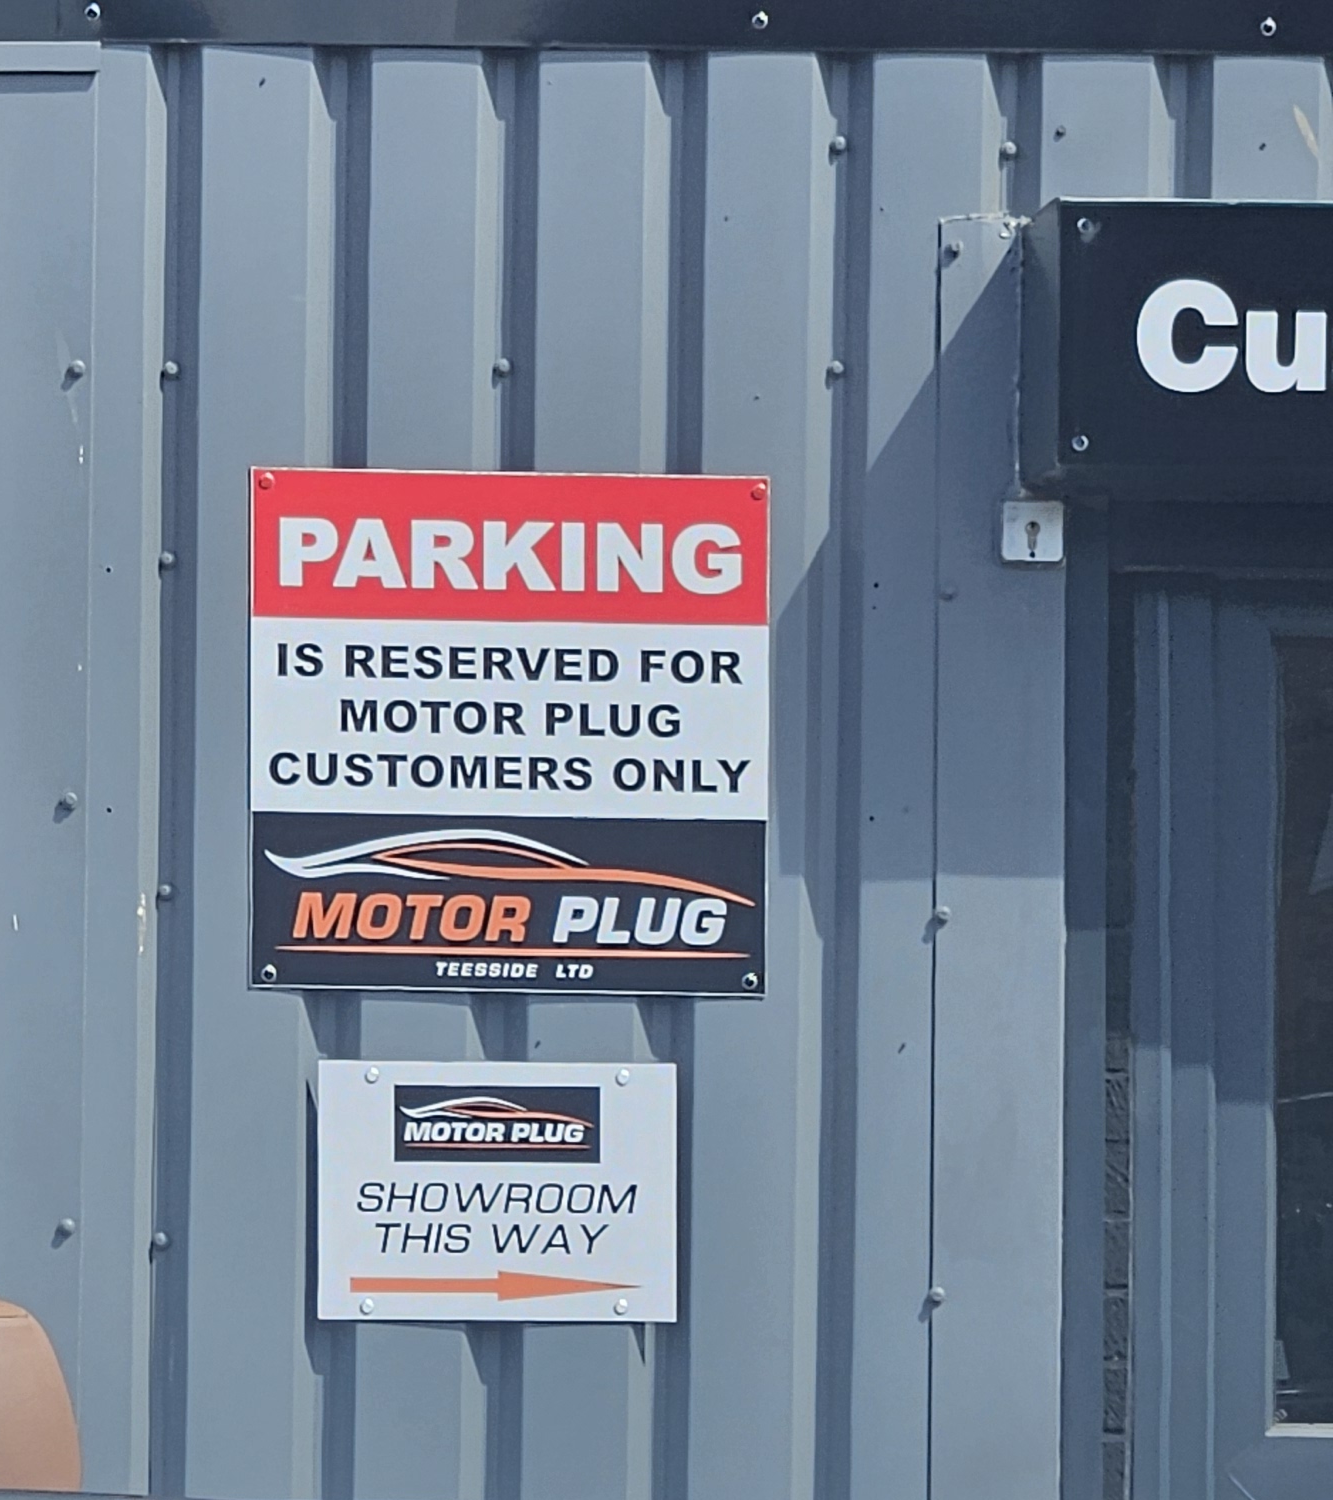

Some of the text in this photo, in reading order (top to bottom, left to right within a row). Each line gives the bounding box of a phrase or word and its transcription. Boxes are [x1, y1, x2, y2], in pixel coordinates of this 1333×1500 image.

[1137, 279, 1333, 393] Cu
[278, 516, 743, 595] PARKING
[277, 643, 743, 685] IS RESERVED FOR
[340, 700, 681, 738] MOTOR PLUG
[268, 752, 751, 793] CUSTOMERS ONLY
[292, 892, 728, 945] MOTOR PLUG
[435, 961, 594, 979] TEESSIDE LTD
[404, 1121, 585, 1143] MOTOR PLUG
[357, 1182, 638, 1214] SHOWROOM
[375, 1223, 609, 1255] THIS WAY
